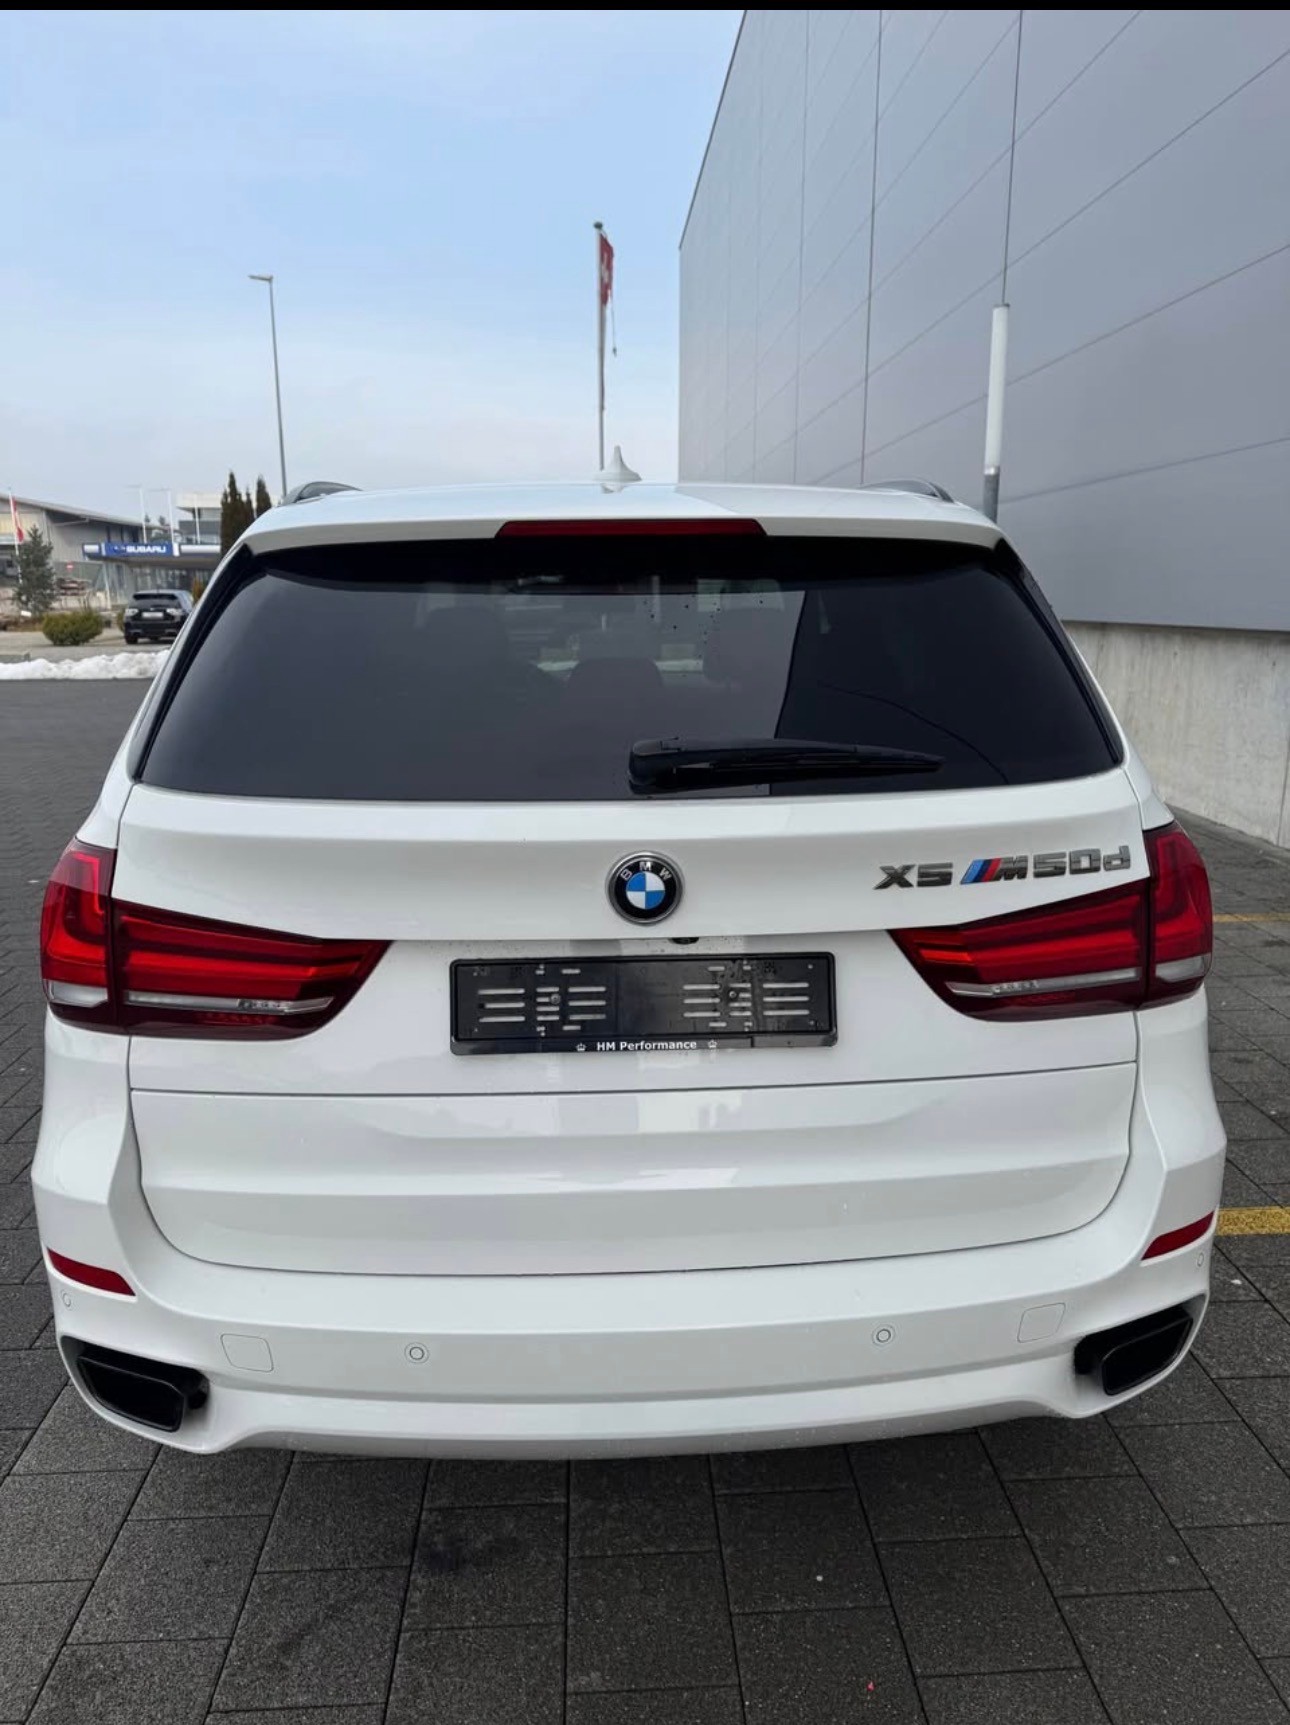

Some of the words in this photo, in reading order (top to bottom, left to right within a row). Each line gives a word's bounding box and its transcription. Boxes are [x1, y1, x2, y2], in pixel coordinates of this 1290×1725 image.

[126, 545, 166, 554] SUBARU
[620, 861, 672, 880] BMW
[873, 863, 953, 890] X5
[597, 1041, 615, 1051] HM
[620, 1039, 697, 1051] Performance
